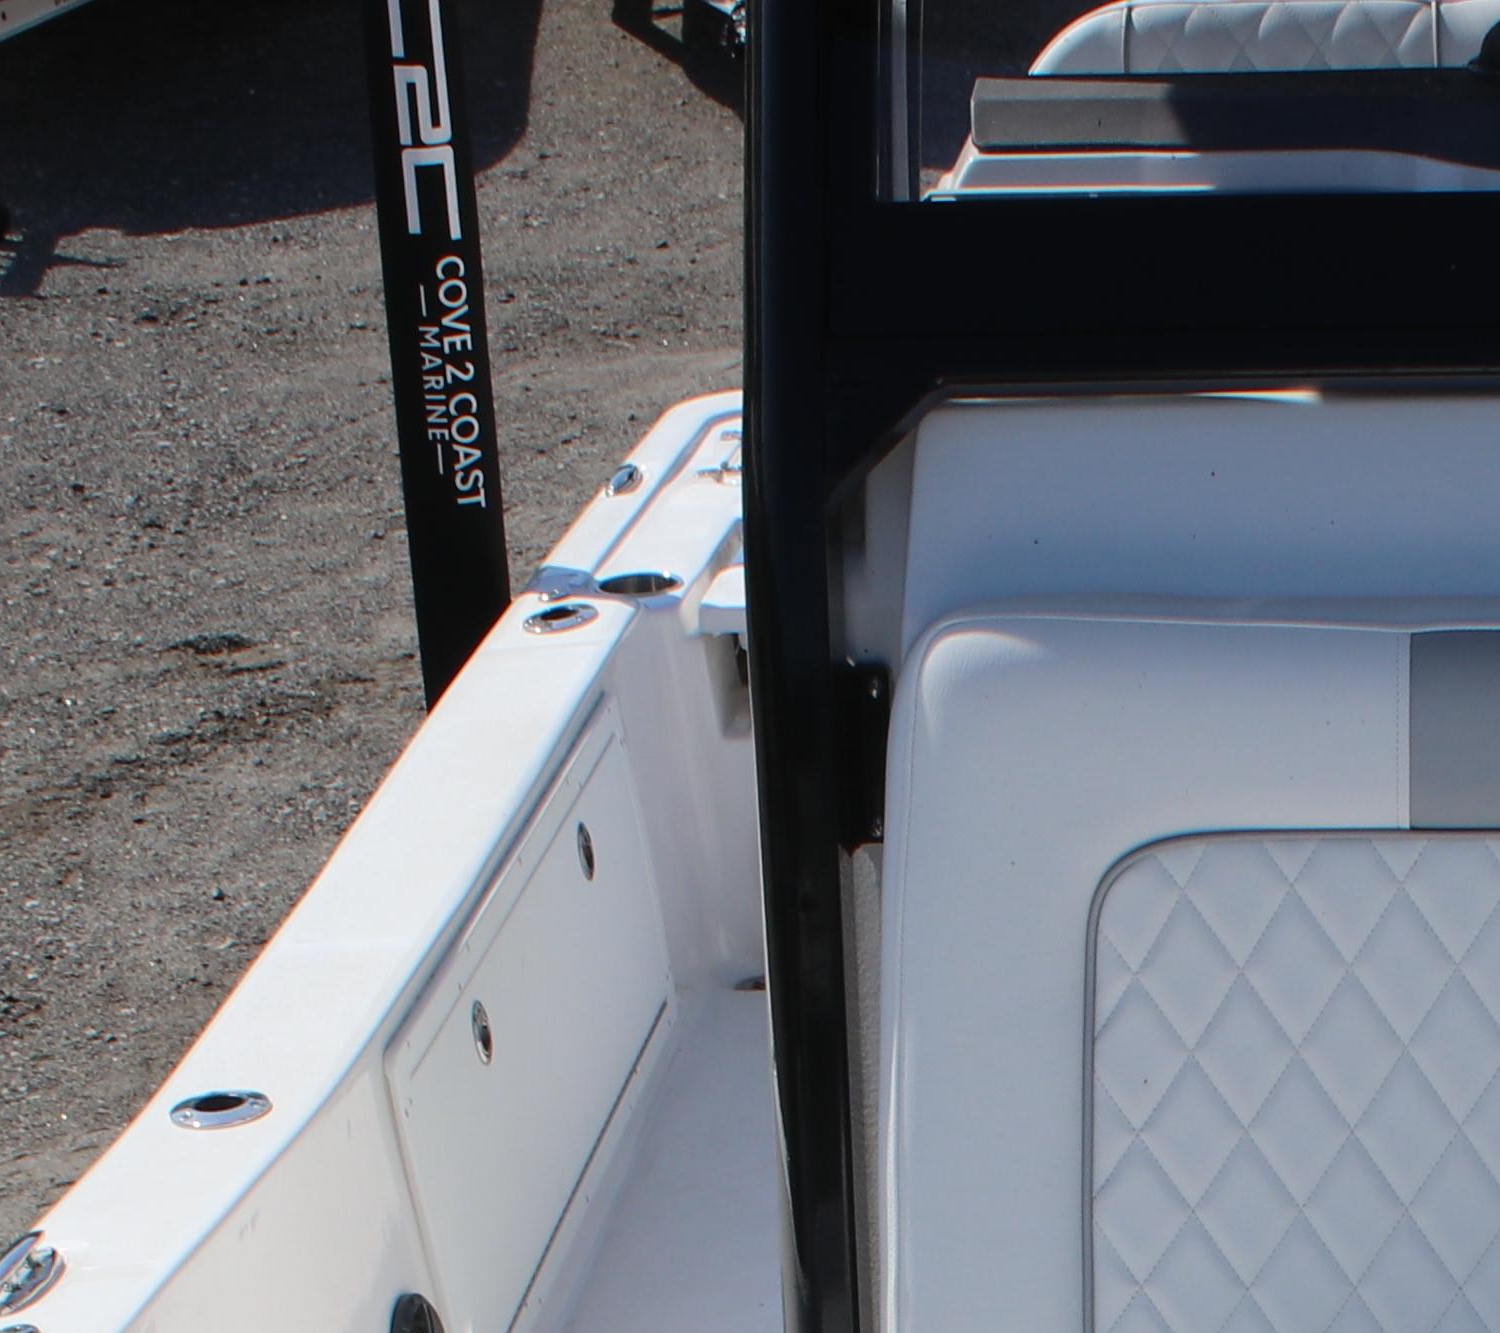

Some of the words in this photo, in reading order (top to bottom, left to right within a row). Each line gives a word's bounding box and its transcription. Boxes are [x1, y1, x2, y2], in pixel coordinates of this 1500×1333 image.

[435, 255, 473, 355] COVE
[418, 326, 450, 441] MARINE
[445, 361, 475, 384] 2
[448, 392, 486, 508] COAST
